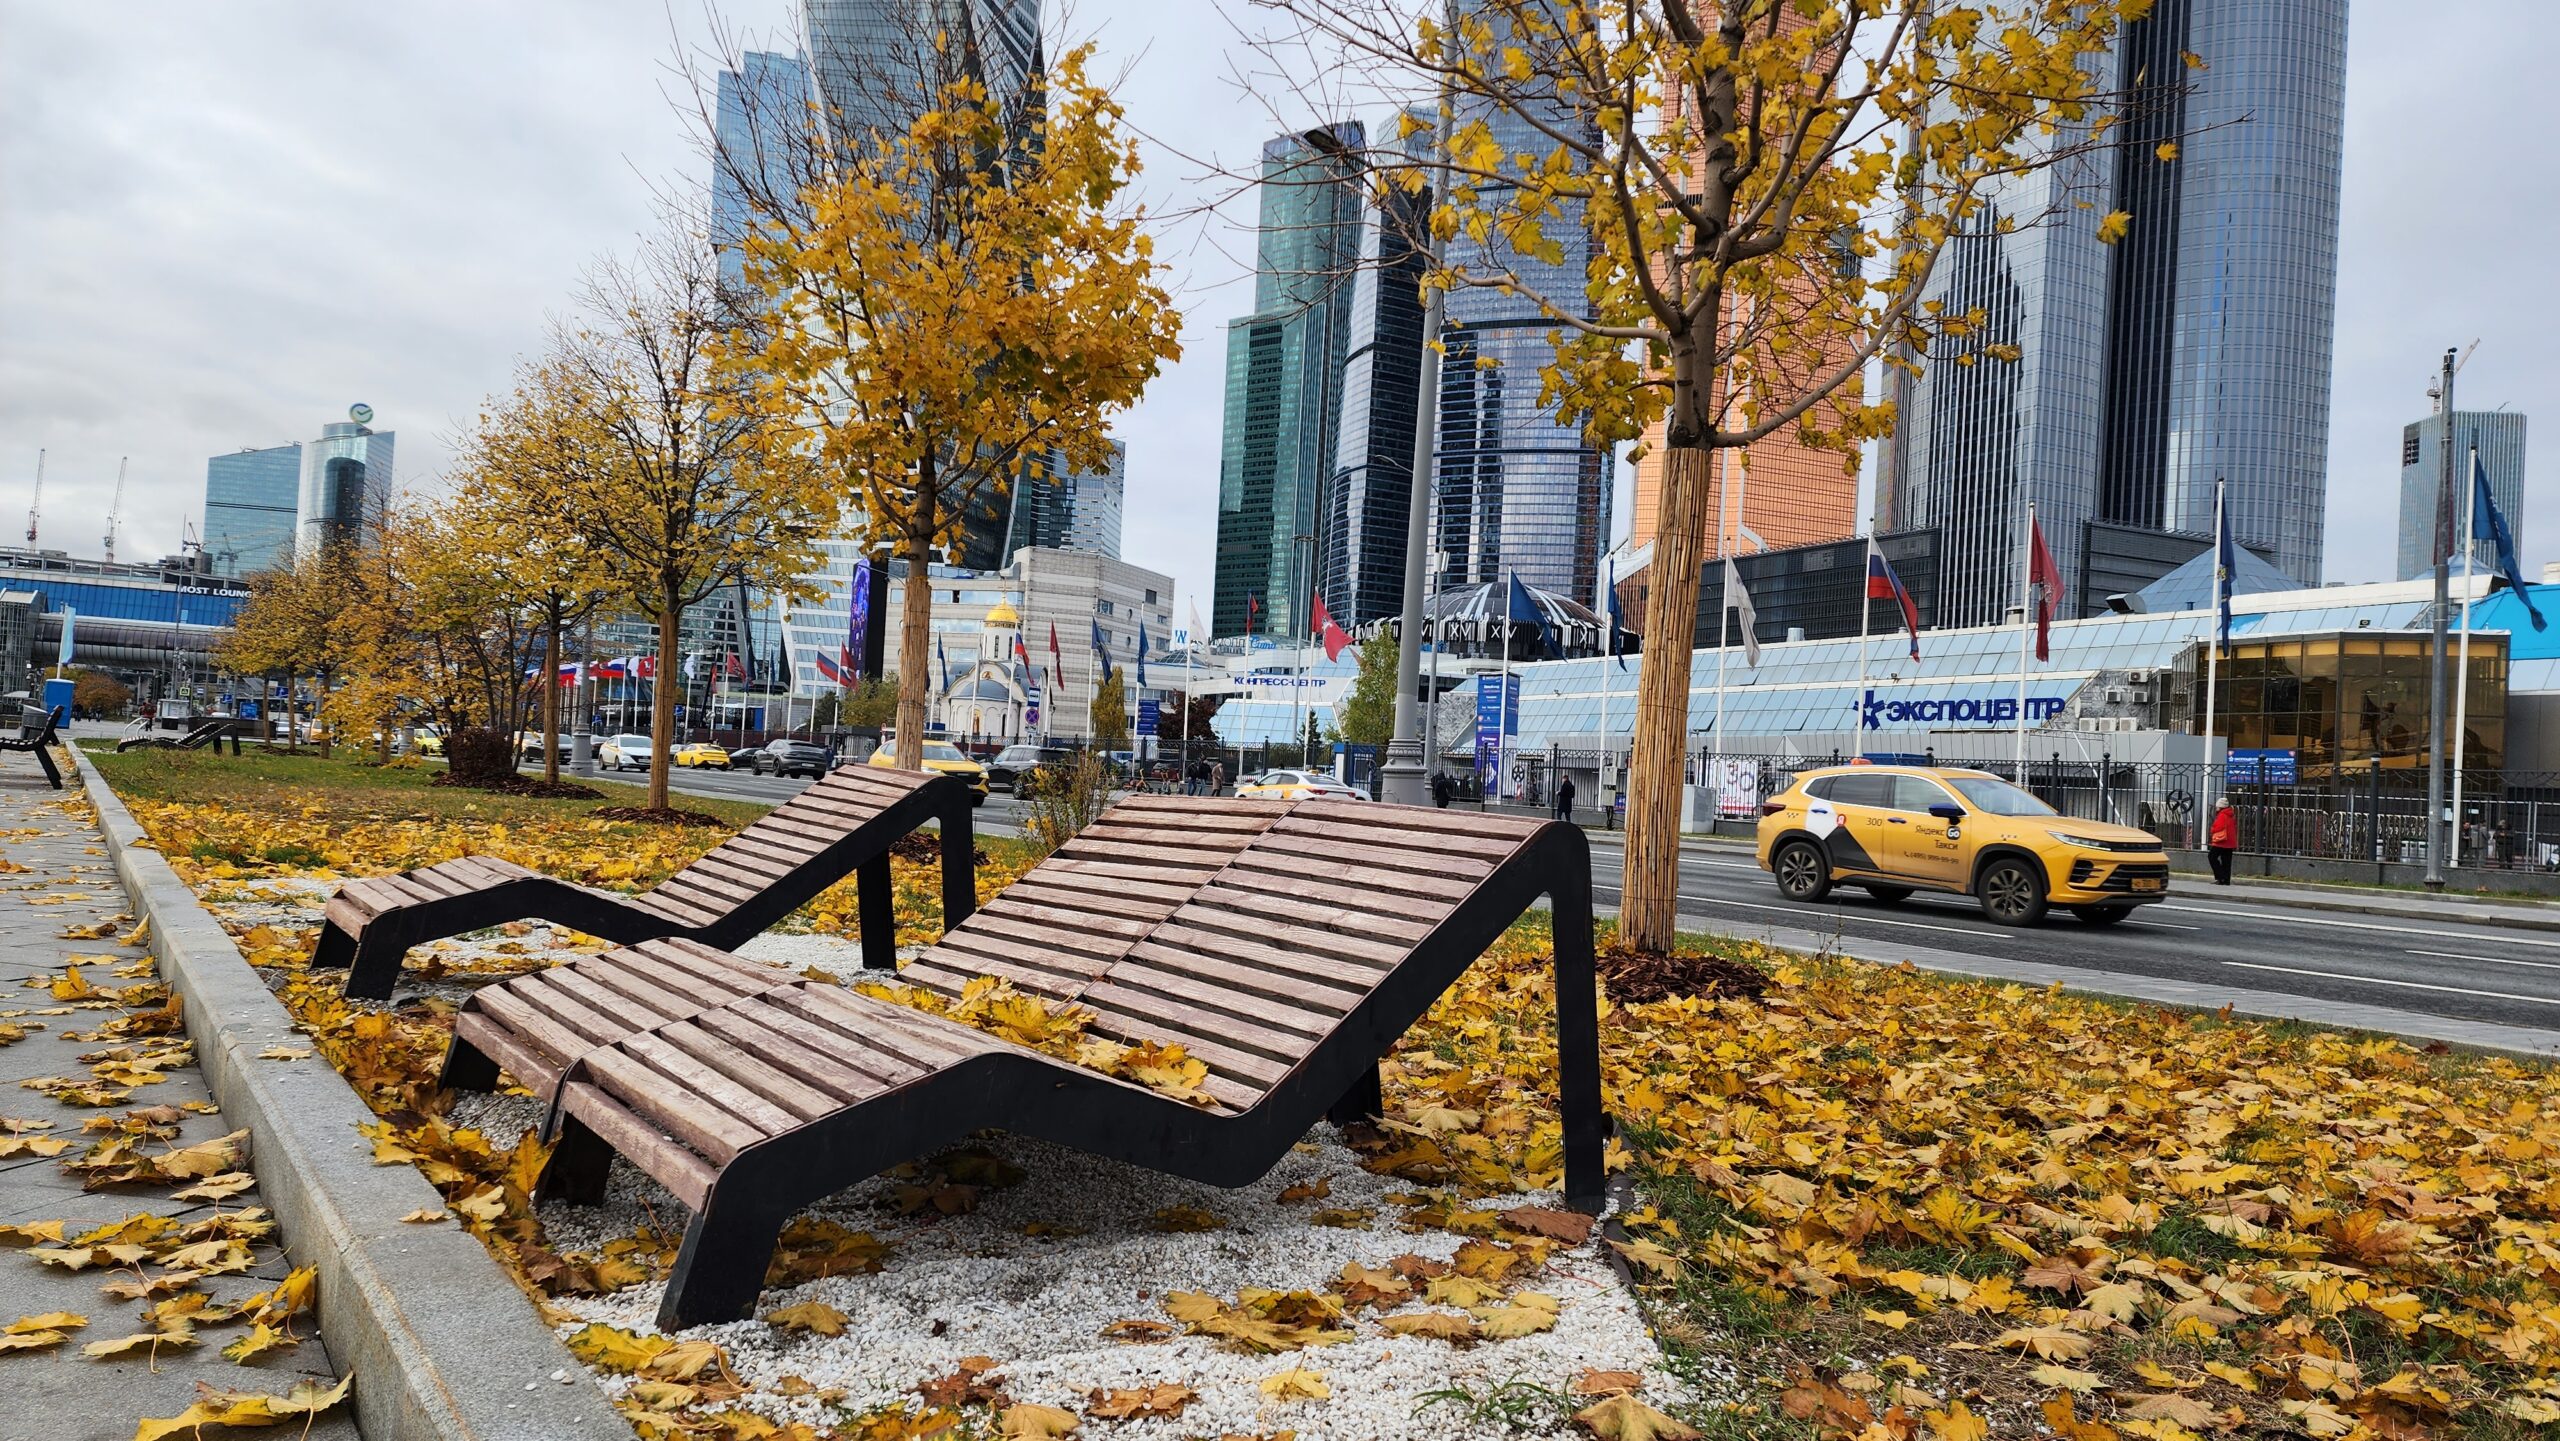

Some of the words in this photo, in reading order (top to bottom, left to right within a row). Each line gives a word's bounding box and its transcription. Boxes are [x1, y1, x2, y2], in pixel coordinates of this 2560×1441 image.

[177, 585, 210, 595] MOST
[213, 588, 255, 599] LOUNG
[1234, 676, 1326, 688] КОНГРЕСС-ЦЕНТР
[1886, 697, 2066, 724] ЭКСПОЦЕНТР
[1866, 817, 1883, 827] 300
[1915, 825, 1945, 837] Яндекс
[1947, 826, 1960, 839] Go
[1934, 839, 1959, 850] Такси
